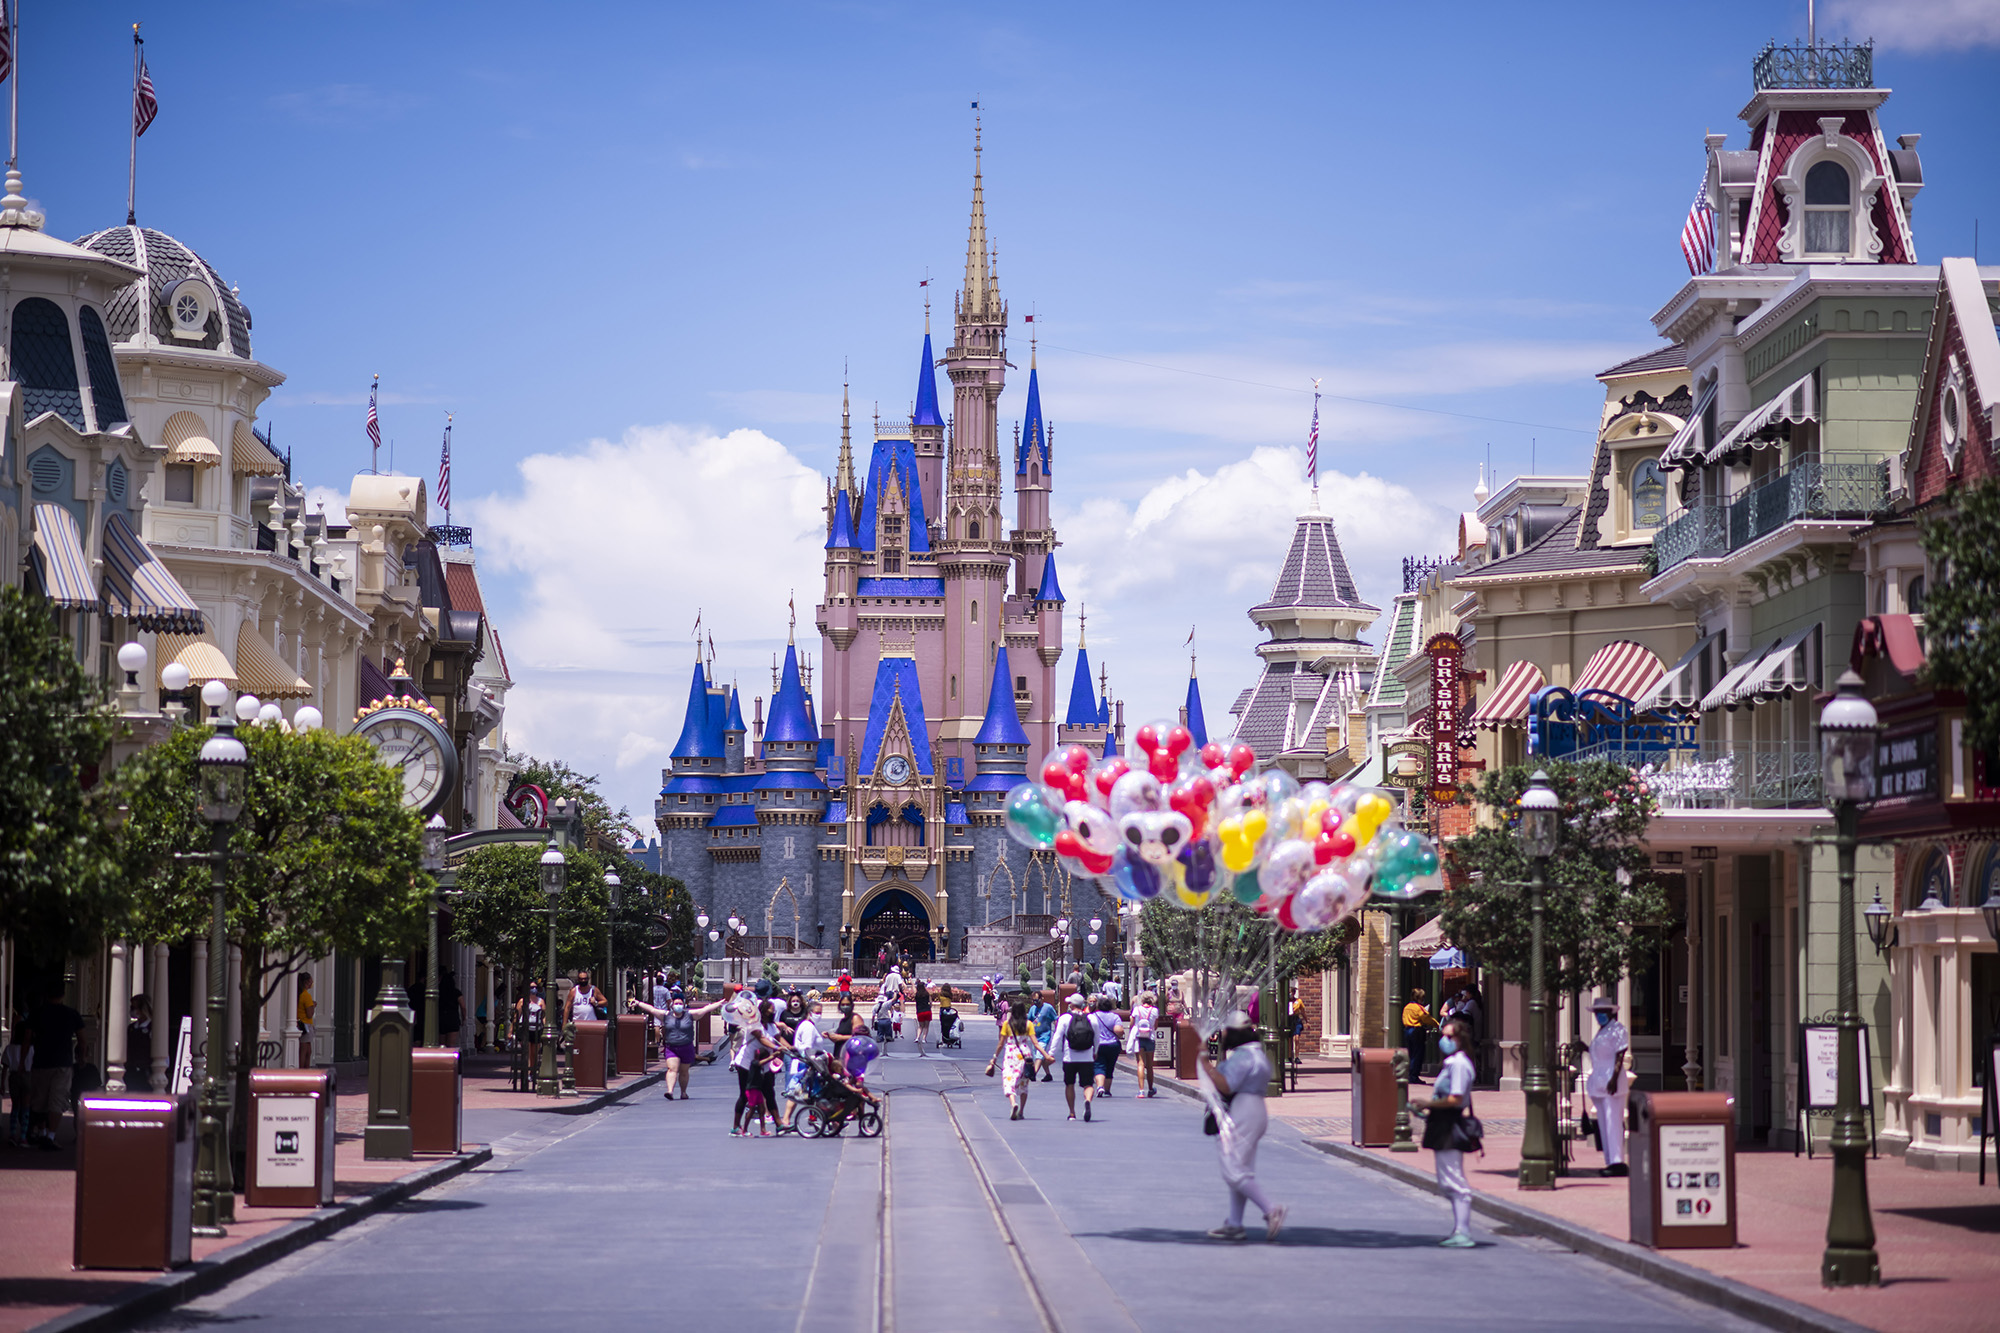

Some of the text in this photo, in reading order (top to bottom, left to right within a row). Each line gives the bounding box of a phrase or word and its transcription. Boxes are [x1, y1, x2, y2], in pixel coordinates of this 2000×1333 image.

[1437, 657, 1453, 784] CRYSTAL ARTS
[1392, 776, 1423, 787] COFFEE
